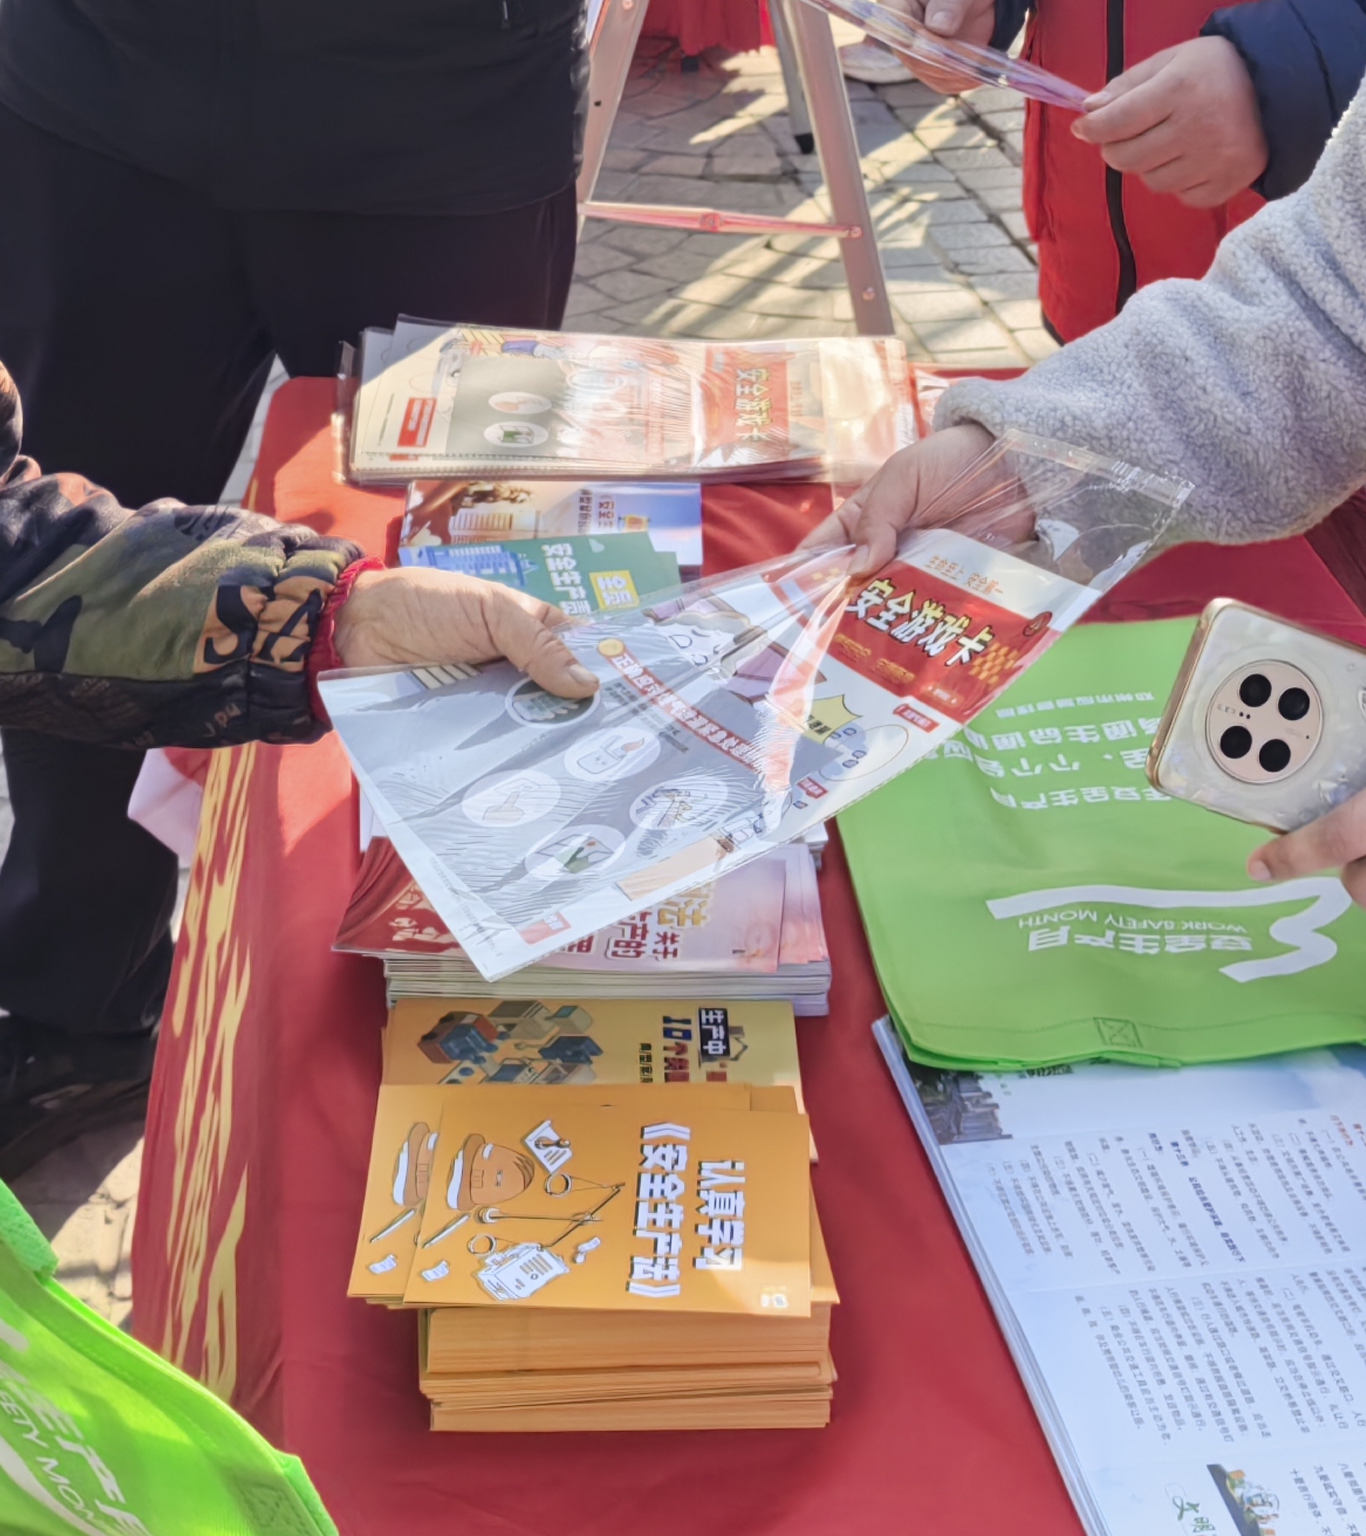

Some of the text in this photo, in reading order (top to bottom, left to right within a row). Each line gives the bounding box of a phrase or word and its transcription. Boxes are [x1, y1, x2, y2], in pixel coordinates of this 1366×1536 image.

[597, 576, 633, 607] 全员
[846, 578, 995, 667] 安全游戏卡
[1019, 909, 1246, 932] WORK SAFETY MONTH
[1029, 925, 1252, 950] 安全生产月
[652, 932, 679, 960] 关于
[699, 1009, 730, 1056] 生产中
[626, 1122, 691, 1298] 《安全生产法》
[692, 1159, 746, 1271] 认真学习
